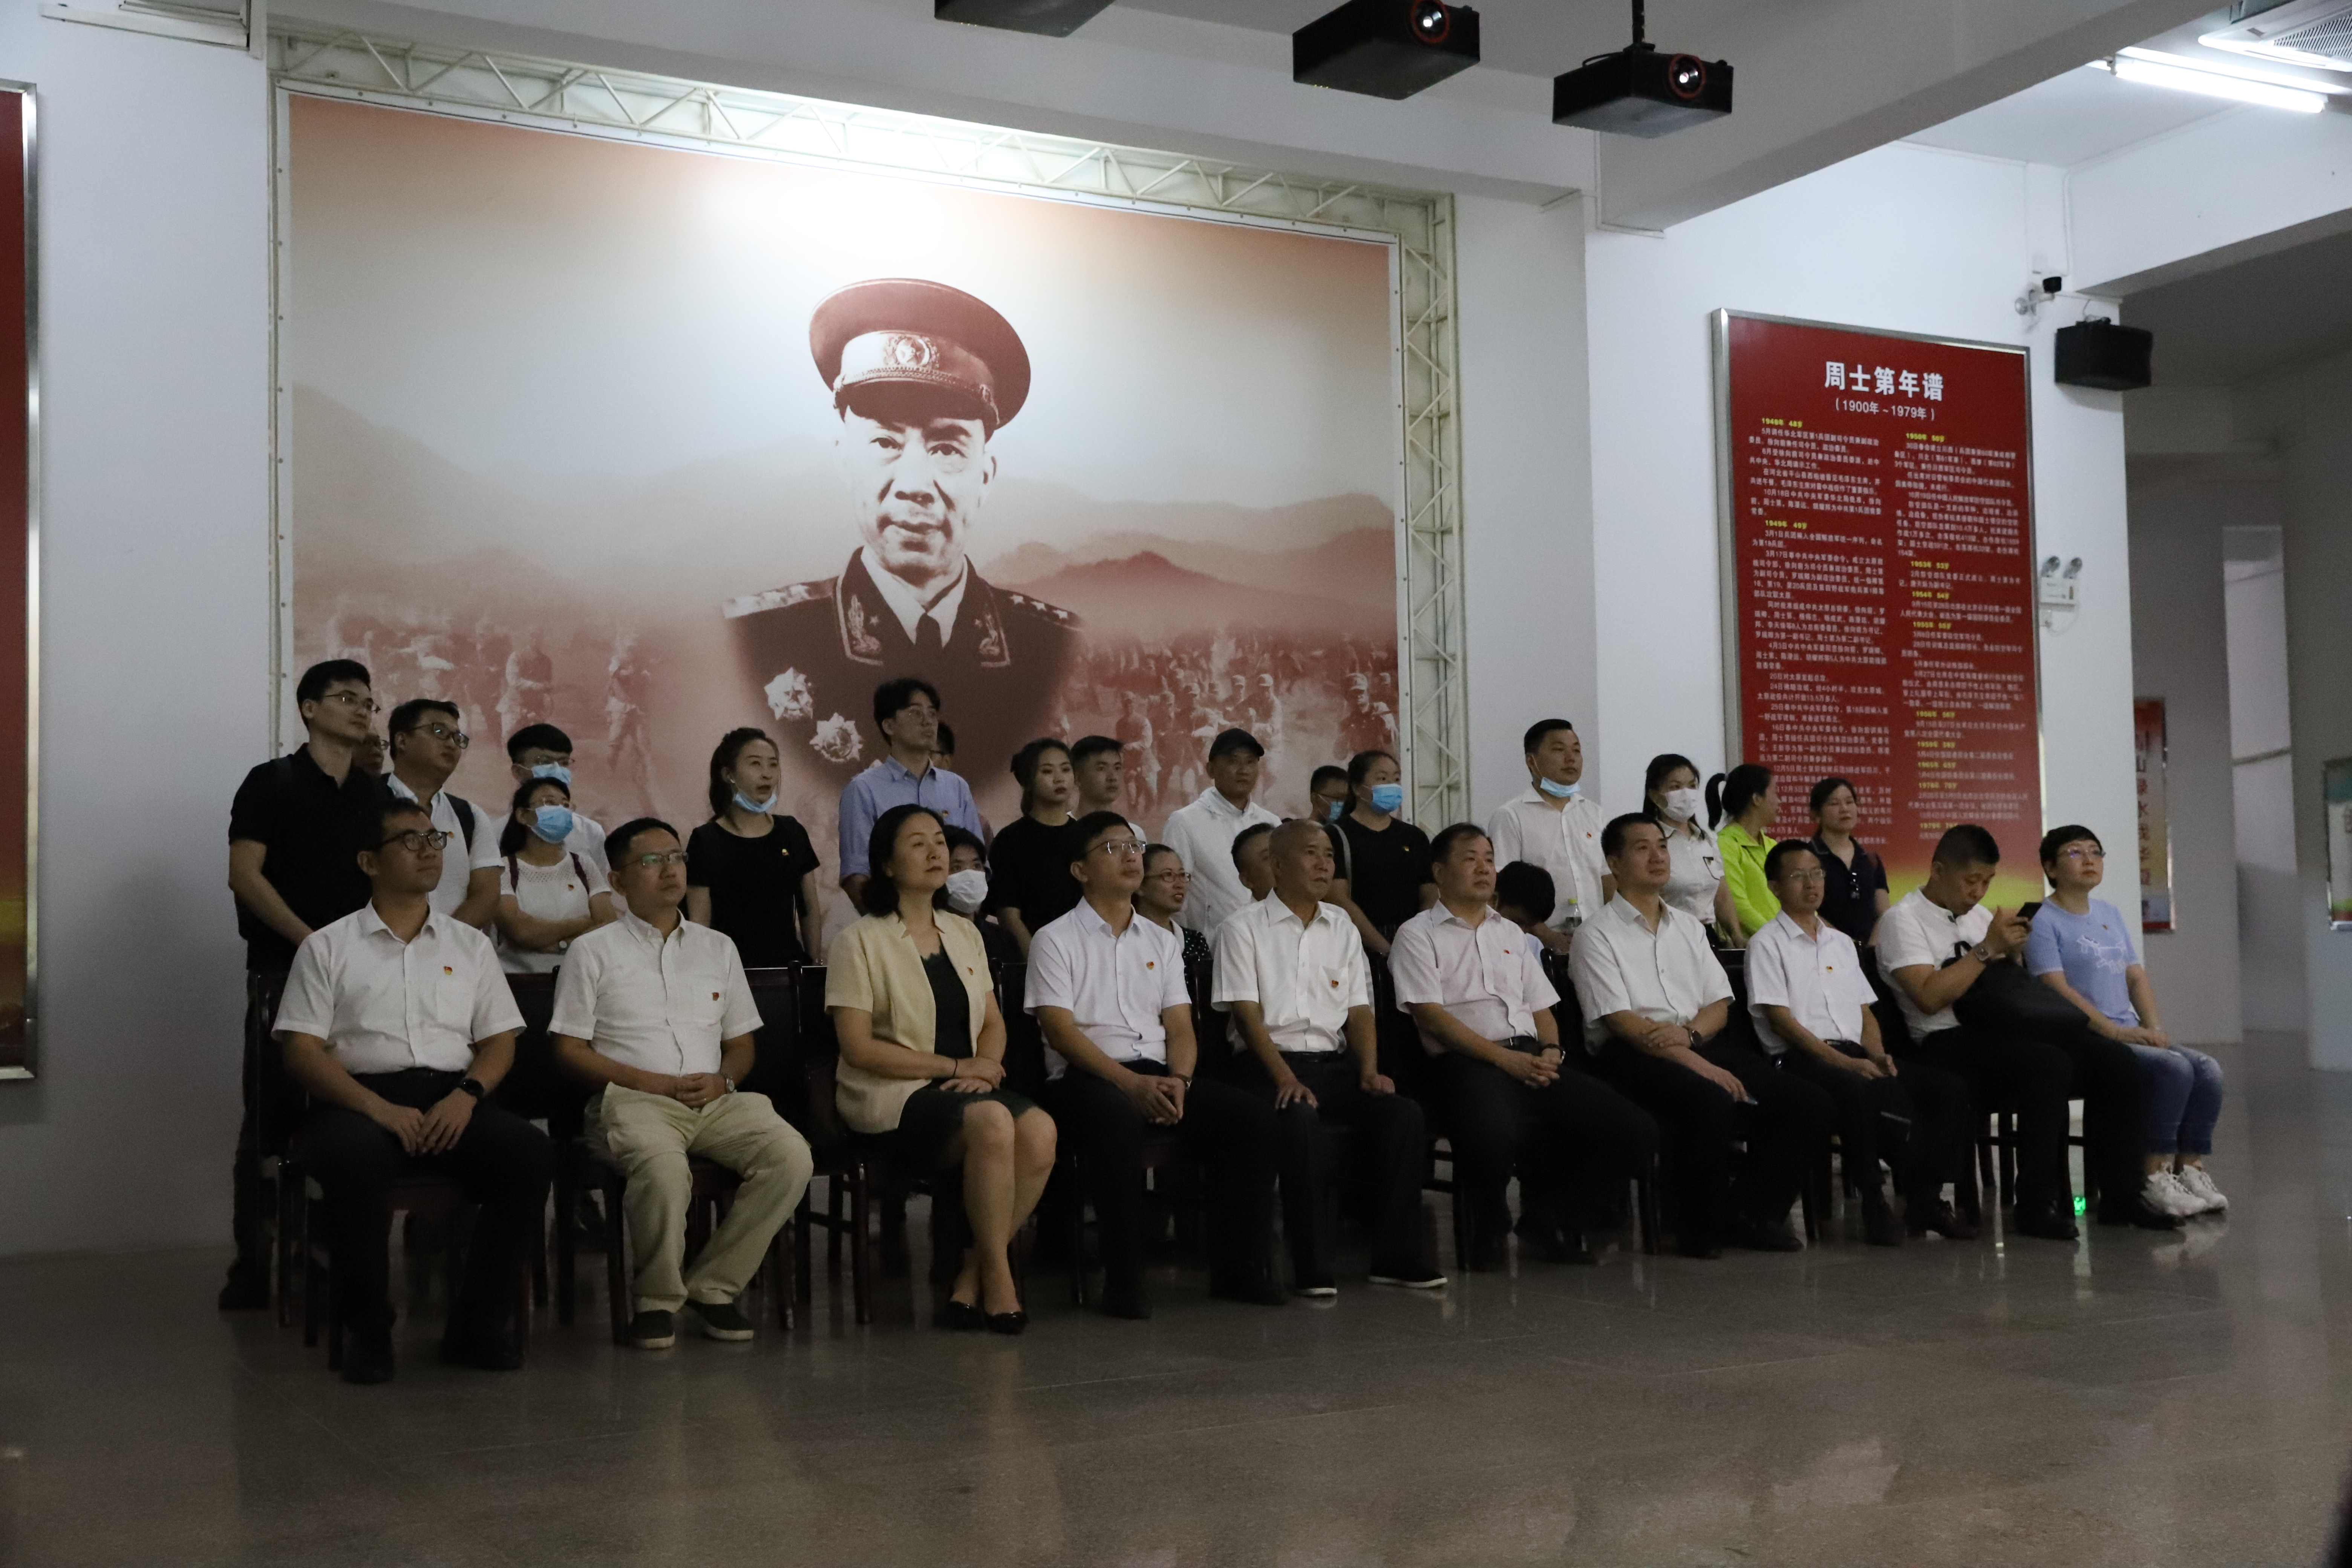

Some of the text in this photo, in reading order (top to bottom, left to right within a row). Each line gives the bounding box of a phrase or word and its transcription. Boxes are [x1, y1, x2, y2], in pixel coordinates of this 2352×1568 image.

[1824, 361, 1943, 401] 周士第年谱
